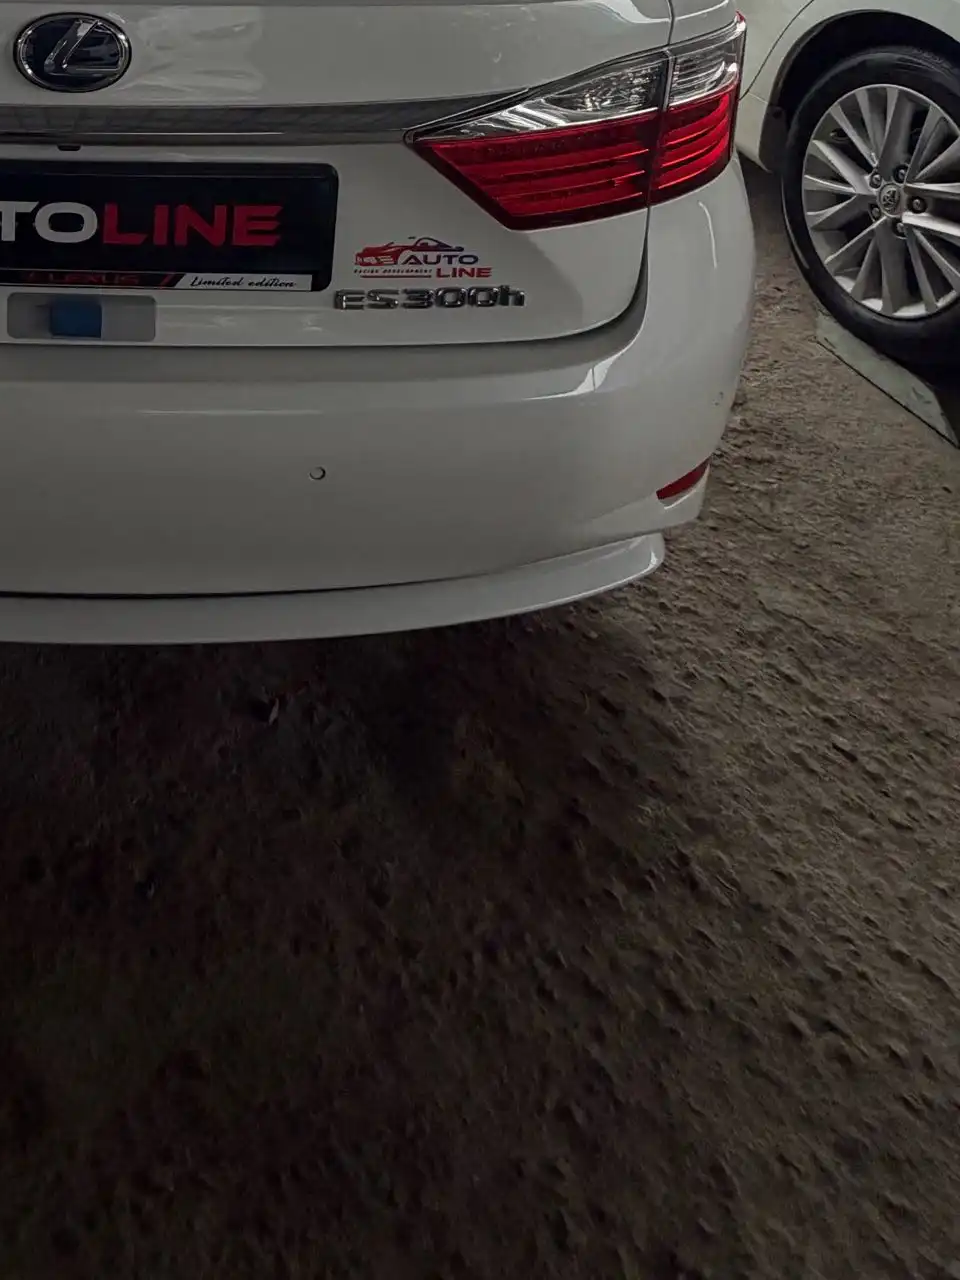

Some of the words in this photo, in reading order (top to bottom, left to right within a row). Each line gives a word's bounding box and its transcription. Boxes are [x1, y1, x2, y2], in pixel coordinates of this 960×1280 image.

[402, 254, 479, 266] AUTO
[435, 267, 493, 279] LINE
[190, 276, 245, 287] Limited
[248, 277, 298, 288] edition
[333, 284, 526, 311] ES300h
